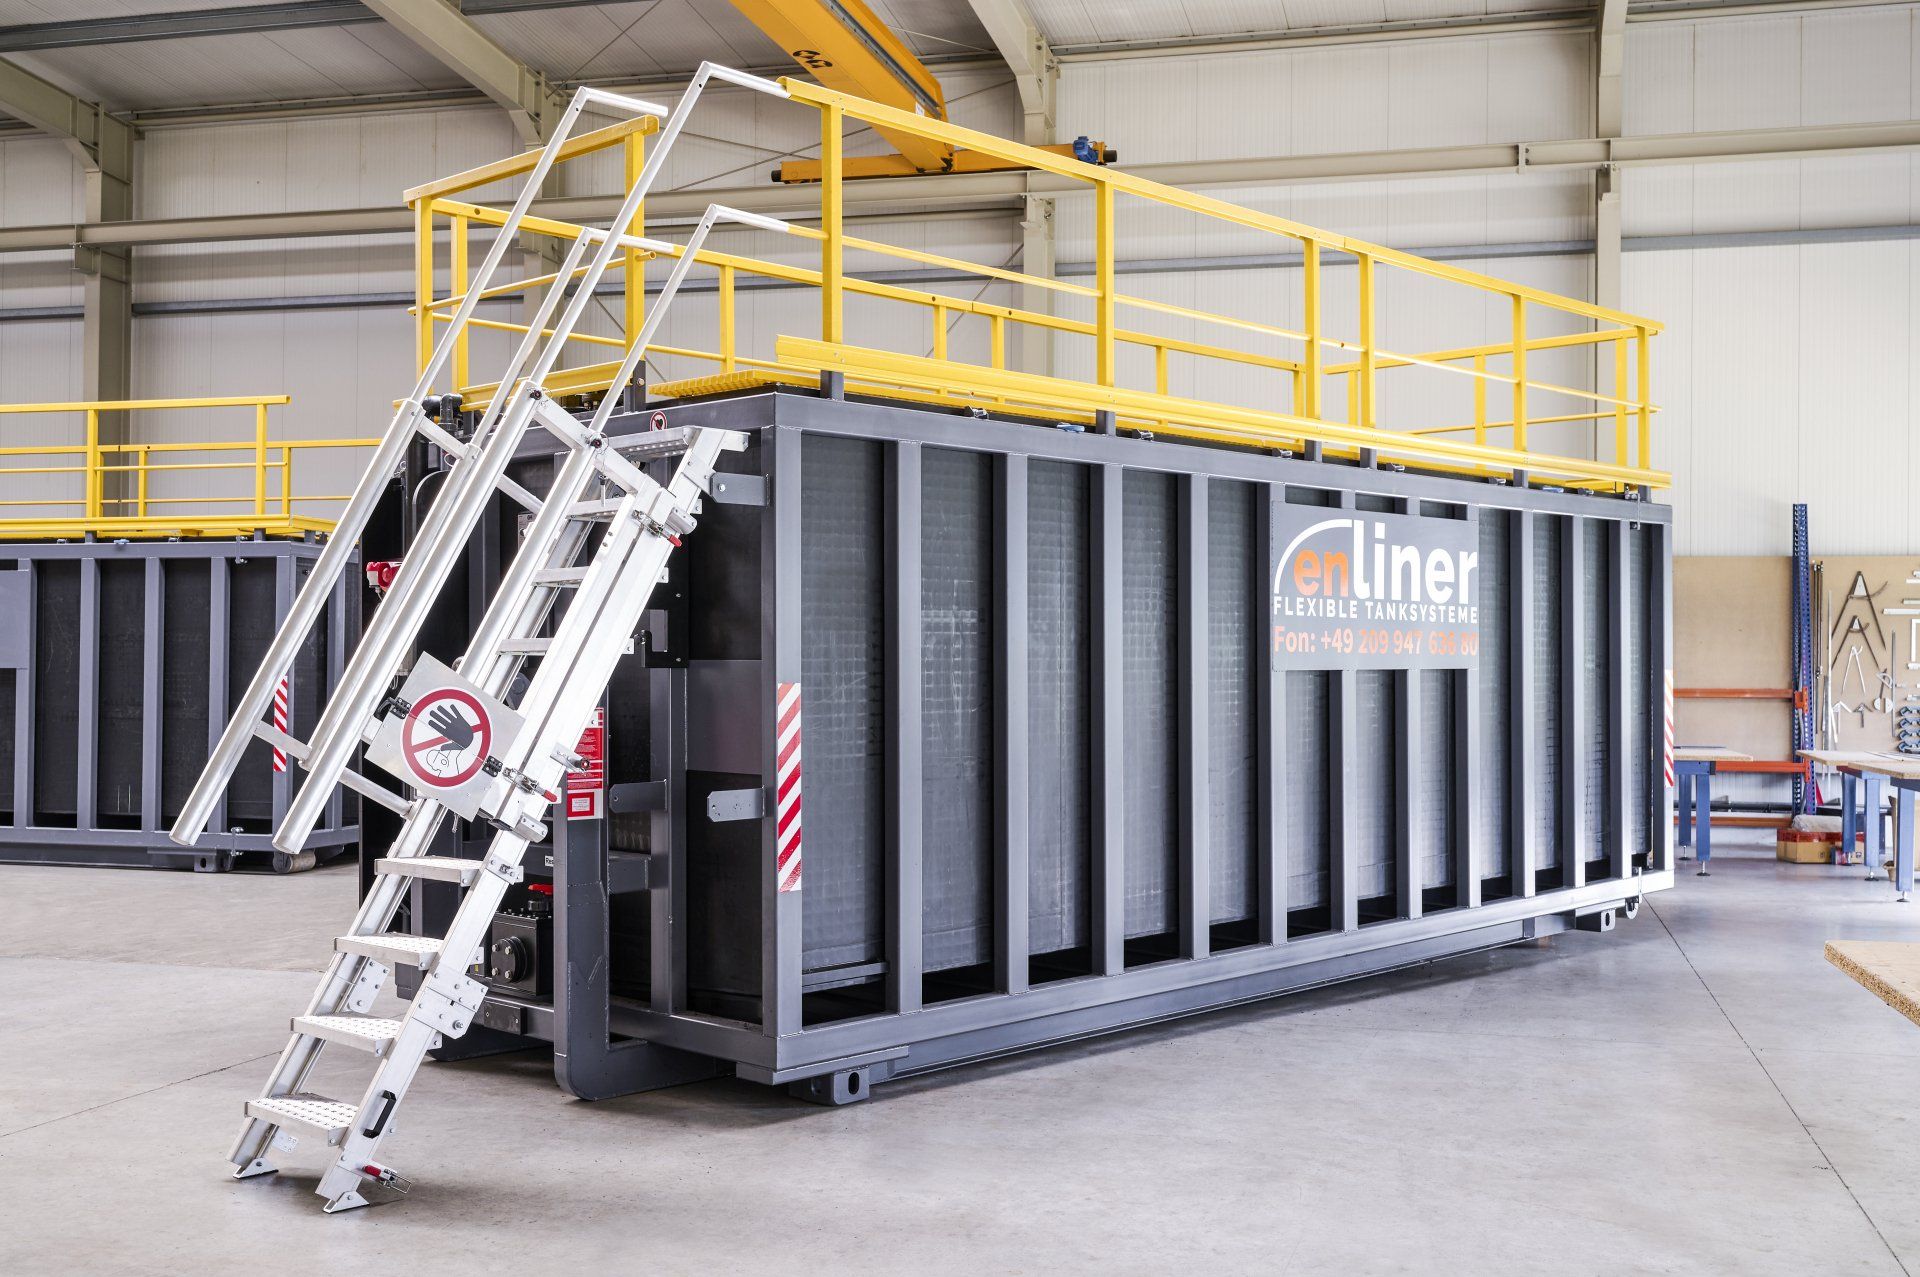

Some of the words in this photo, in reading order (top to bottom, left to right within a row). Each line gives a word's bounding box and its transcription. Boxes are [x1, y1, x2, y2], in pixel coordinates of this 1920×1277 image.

[1293, 519, 1478, 606] enliner
[1273, 596, 1358, 619] FLEXIBLE
[1365, 601, 1478, 624] TANKSYSTEME
[1274, 626, 1316, 653] Fon:
[1320, 628, 1354, 654] +49
[1358, 629, 1389, 655] 209
[1393, 630, 1423, 655] 947
[1460, 632, 1478, 656] 80
